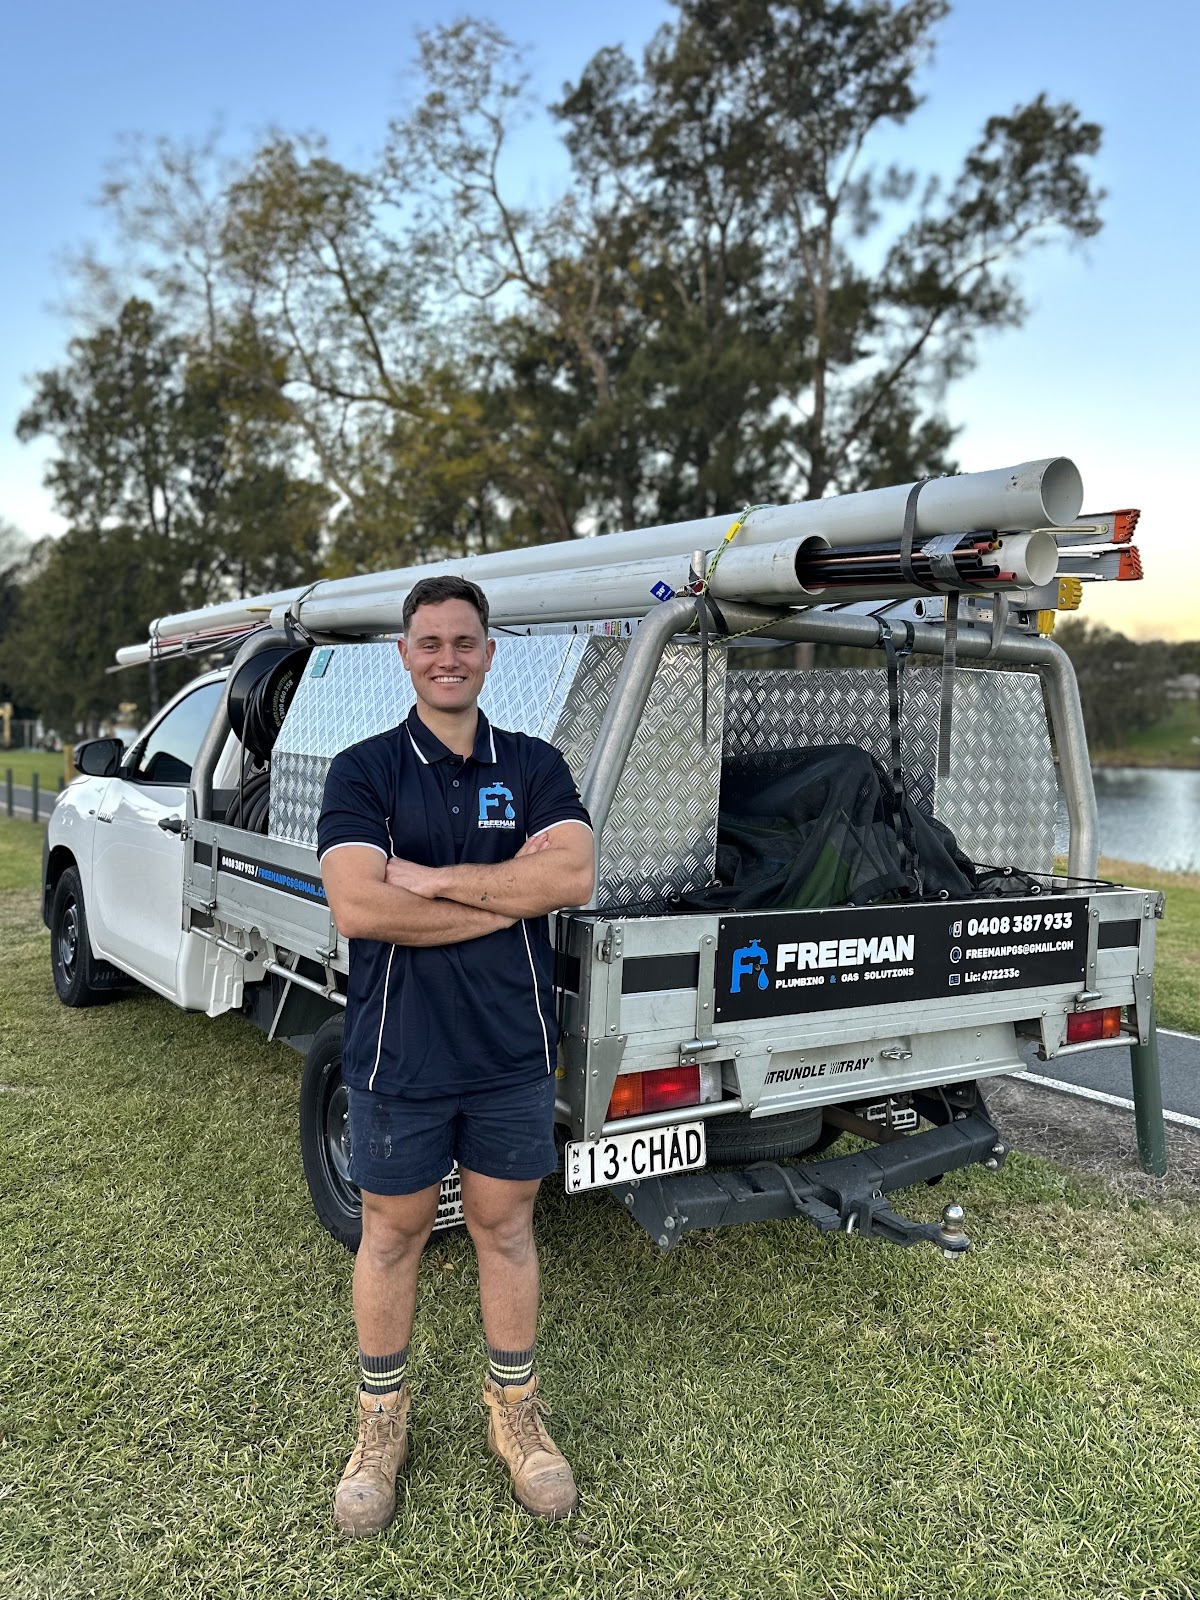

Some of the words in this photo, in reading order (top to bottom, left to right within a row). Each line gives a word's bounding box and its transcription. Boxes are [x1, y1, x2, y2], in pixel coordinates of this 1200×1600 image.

[967, 916, 1010, 936] 0408
[1012, 914, 1042, 933] 387
[1043, 912, 1073, 931] 933
[776, 934, 915, 972] FREEMAN
[965, 940, 1074, 960] FREEMANPGS@GMAIL.COM
[775, 976, 825, 989] PLUMBING
[829, 975, 837, 984] &
[841, 973, 859, 983] GAS
[863, 967, 915, 981] SOLUTIONS
[965, 972, 981, 983] Lic:
[981, 967, 1020, 981] 472233c
[766, 1063, 827, 1084] TRUNDLE
